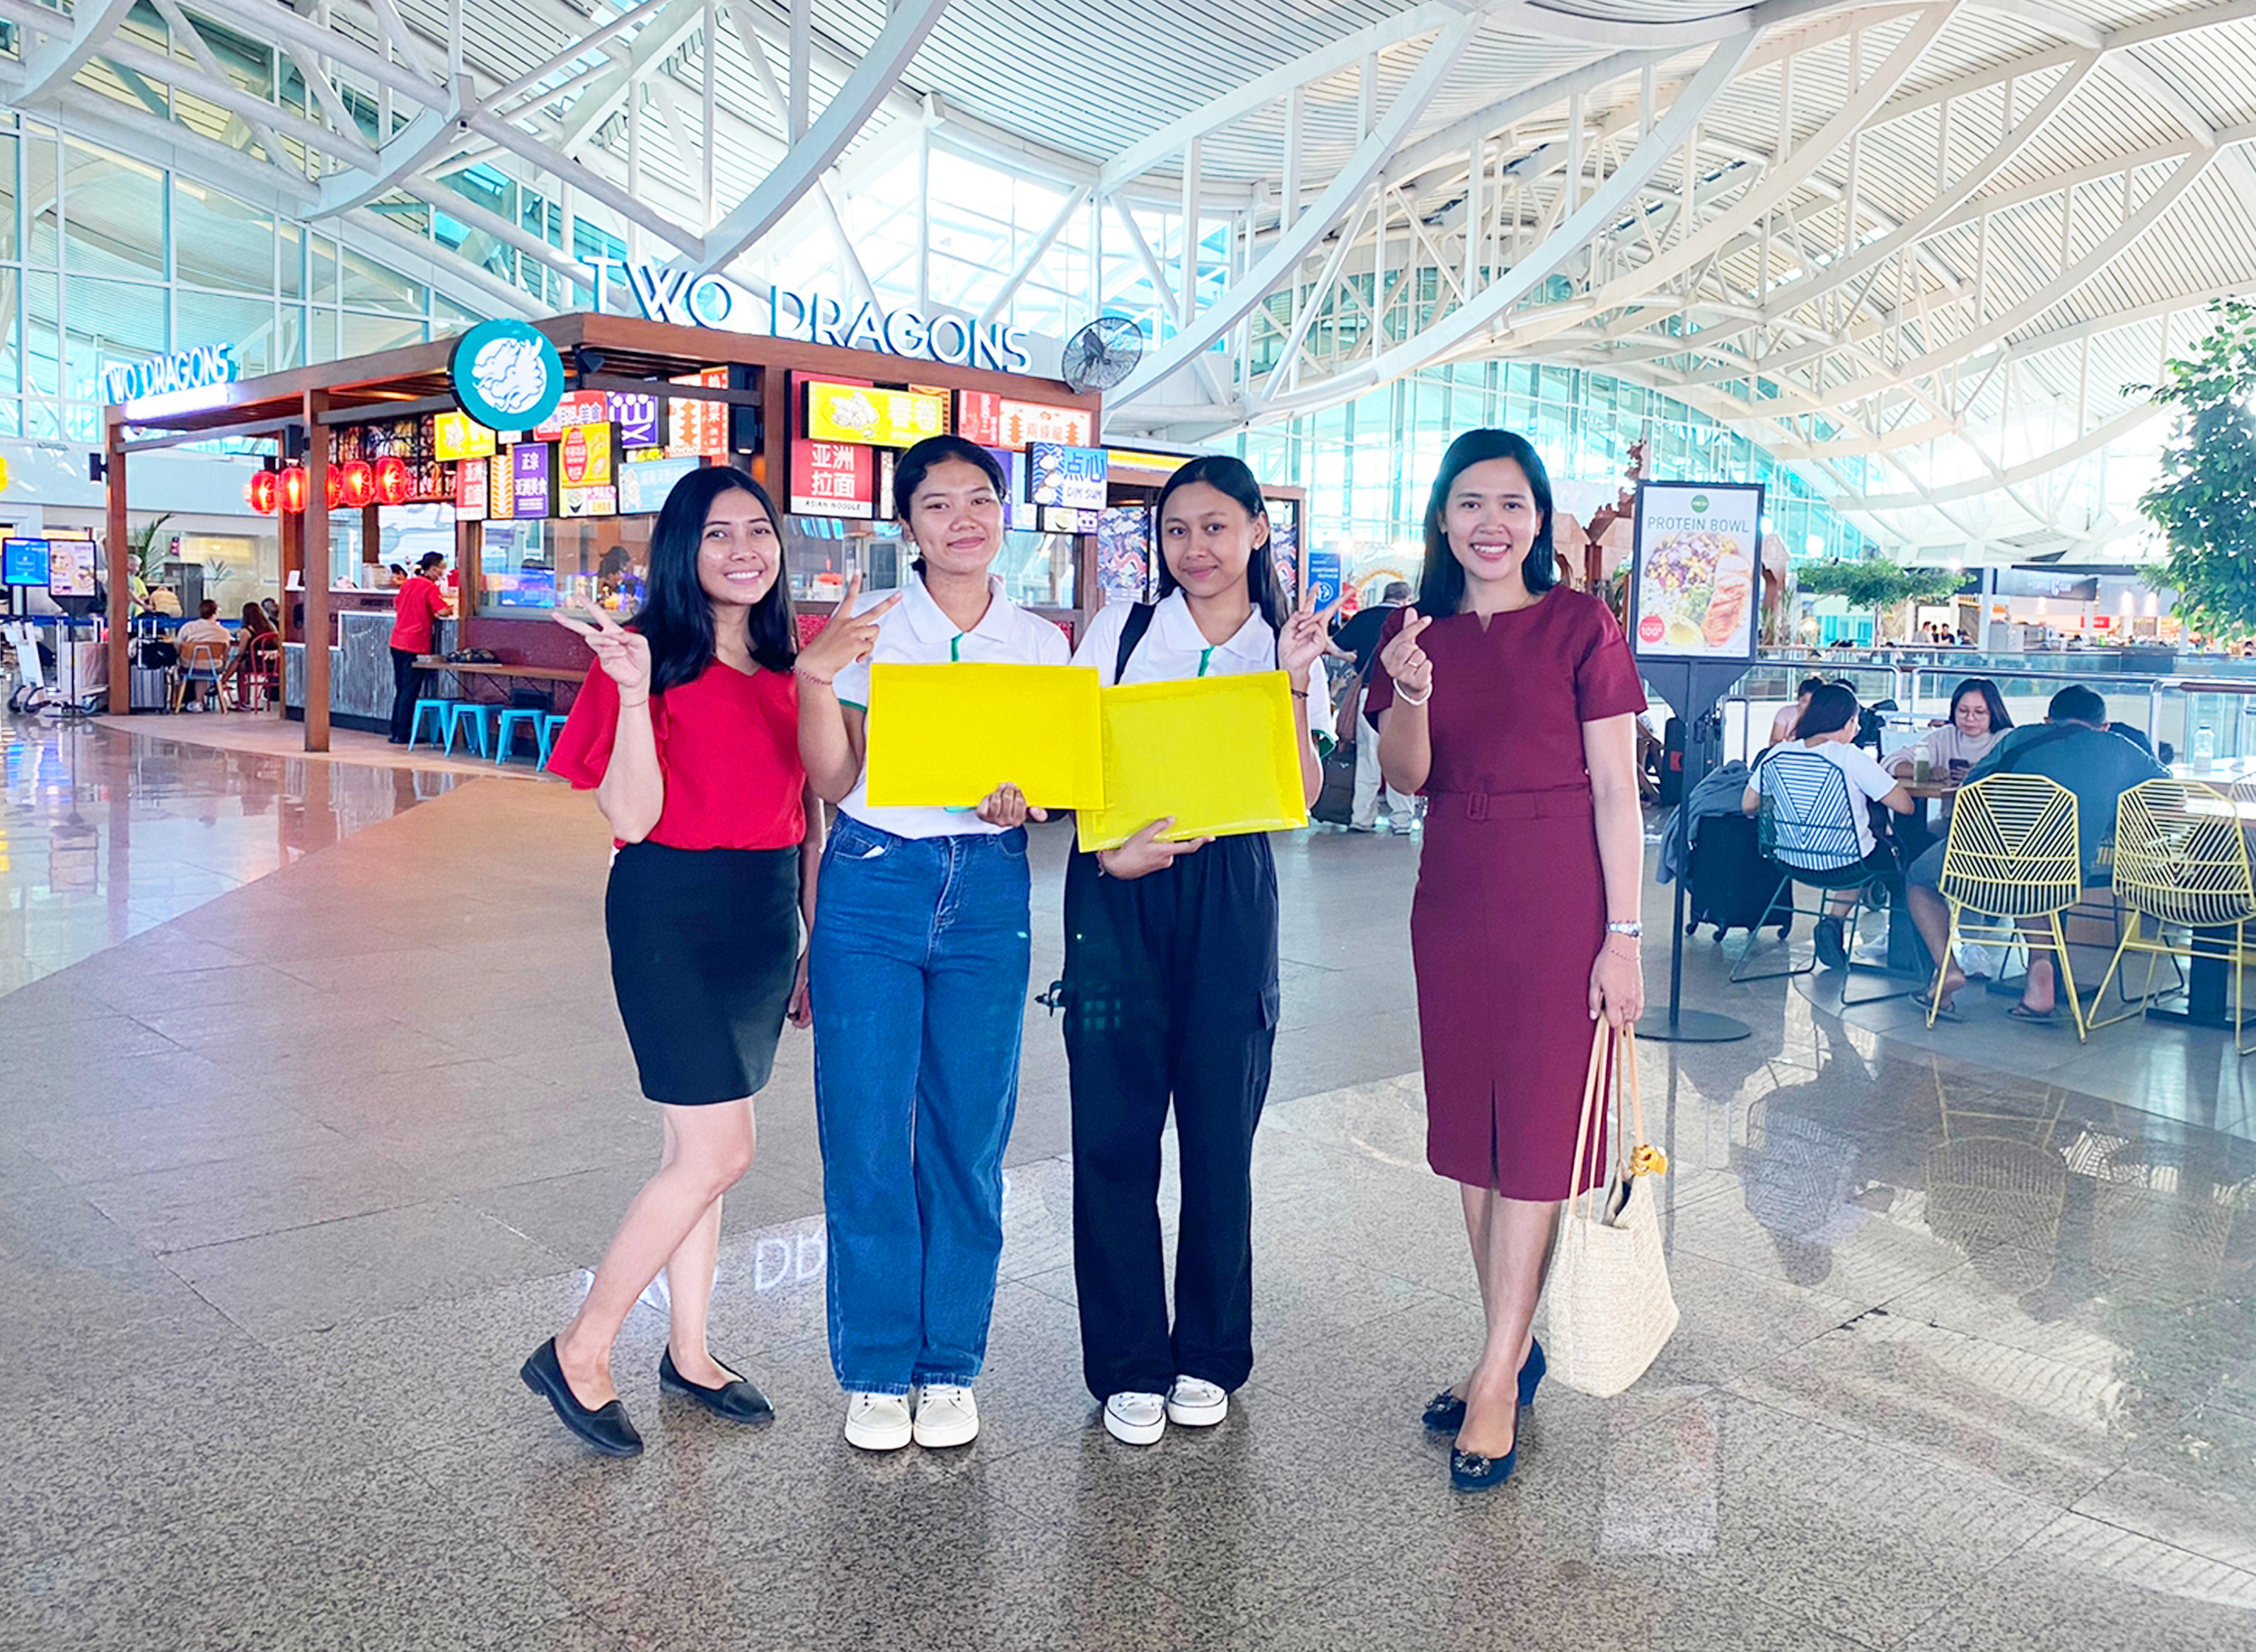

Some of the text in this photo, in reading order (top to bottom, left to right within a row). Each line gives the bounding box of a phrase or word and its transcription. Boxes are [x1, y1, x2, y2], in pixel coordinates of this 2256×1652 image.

[577, 255, 1034, 375] TWO DRAGONS
[100, 342, 236, 405] TWO DRAGONS
[811, 442, 855, 470] 亚洲
[1064, 452, 1106, 483] 点心
[811, 470, 855, 499] 拉面
[1067, 486, 1103, 501] DIM SUM
[804, 499, 861, 511] ASIAN NOODLE
[1648, 516, 1749, 533] PROTEIN BOWL
